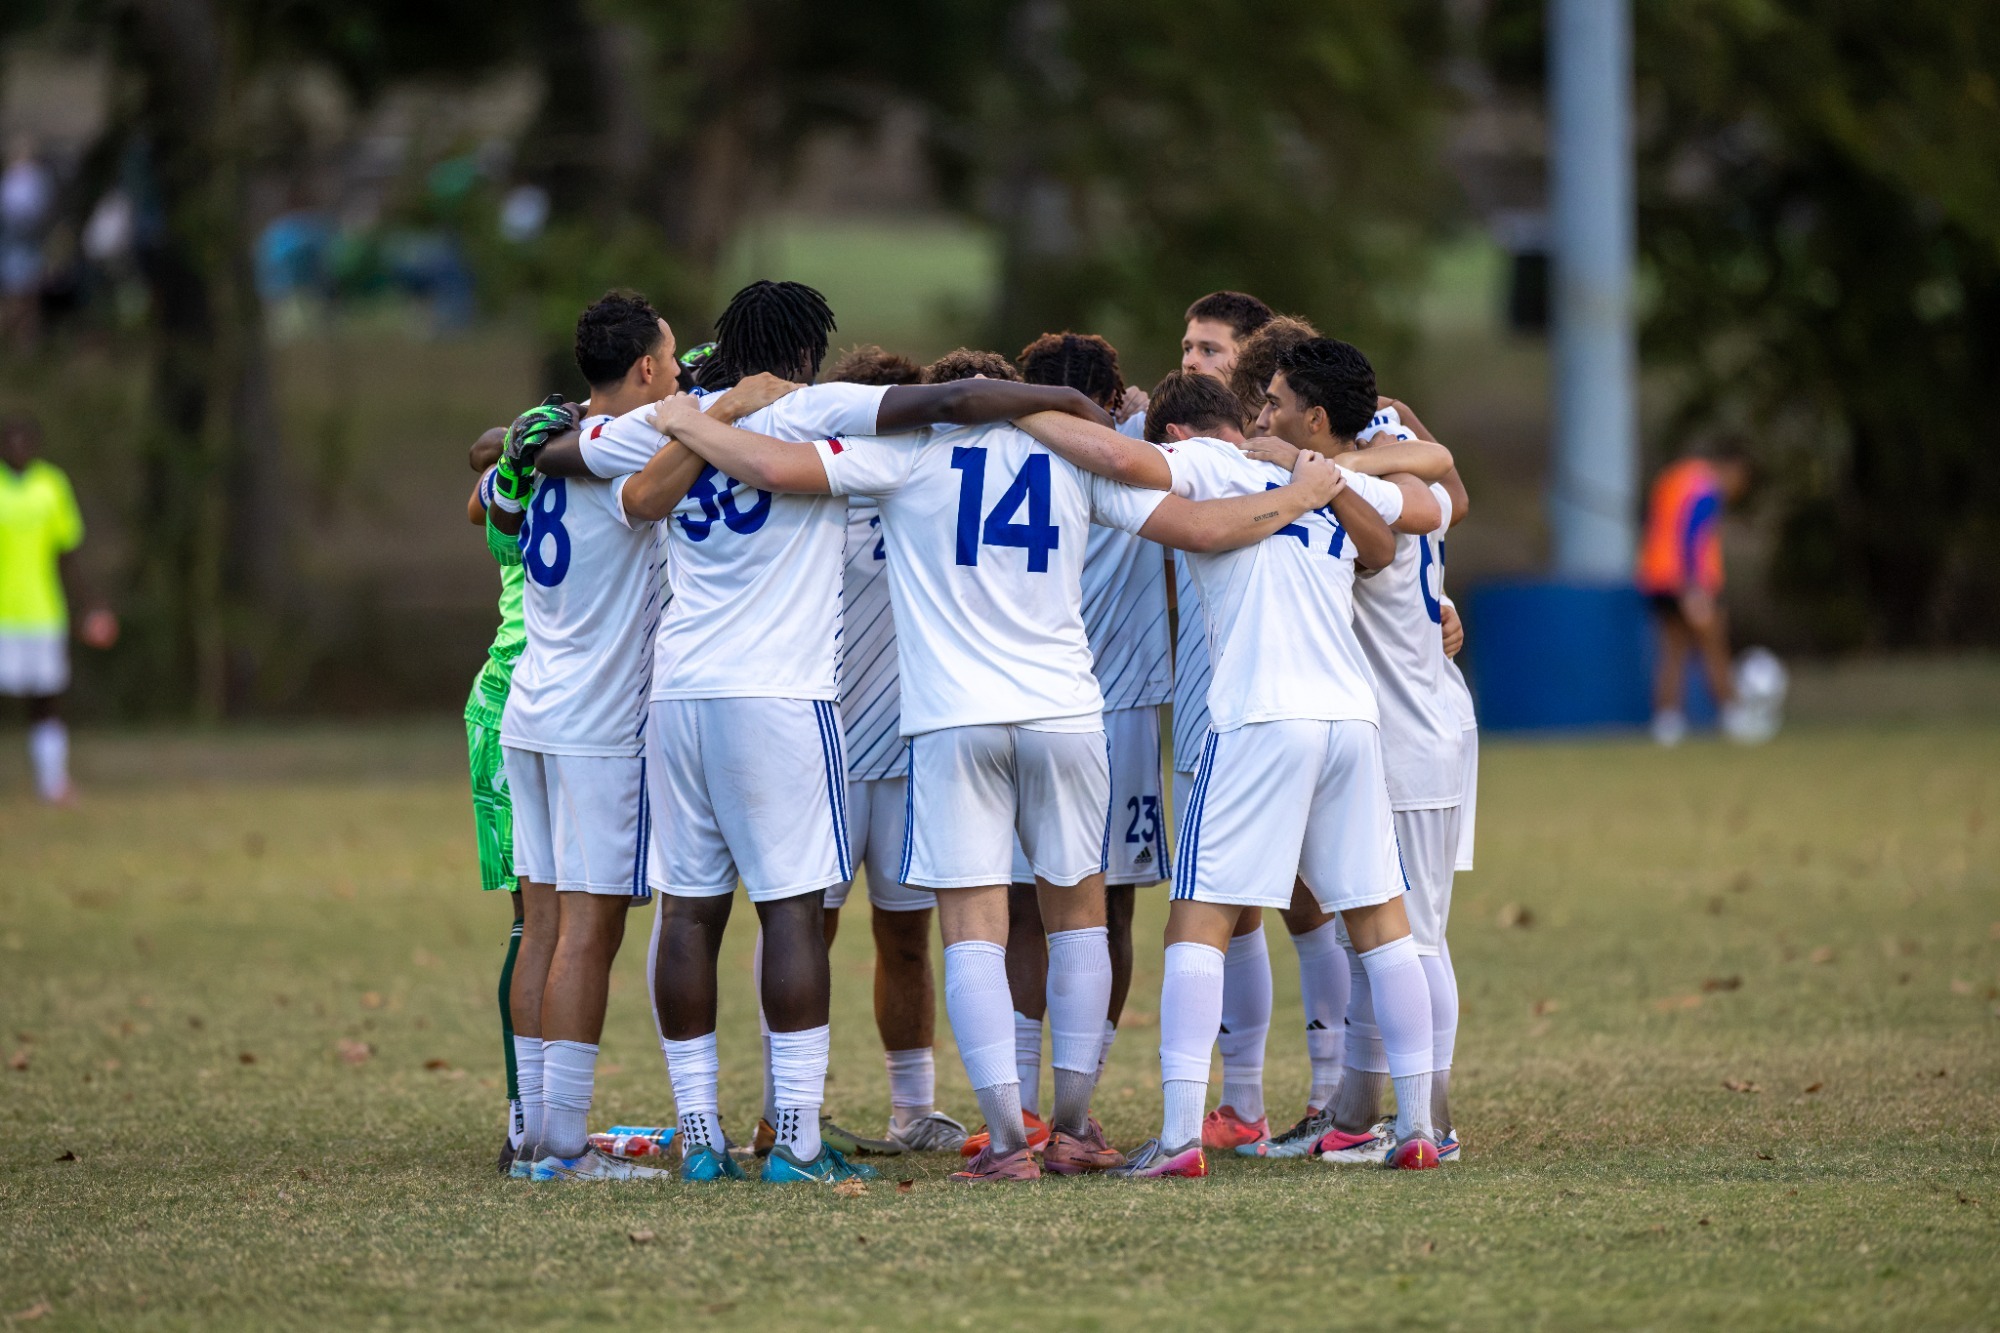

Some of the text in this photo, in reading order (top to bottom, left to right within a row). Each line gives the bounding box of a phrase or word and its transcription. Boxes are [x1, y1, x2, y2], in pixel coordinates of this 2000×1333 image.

[517, 477, 572, 588] 8
[951, 446, 1059, 573] 14
[1125, 796, 1157, 843] 23
